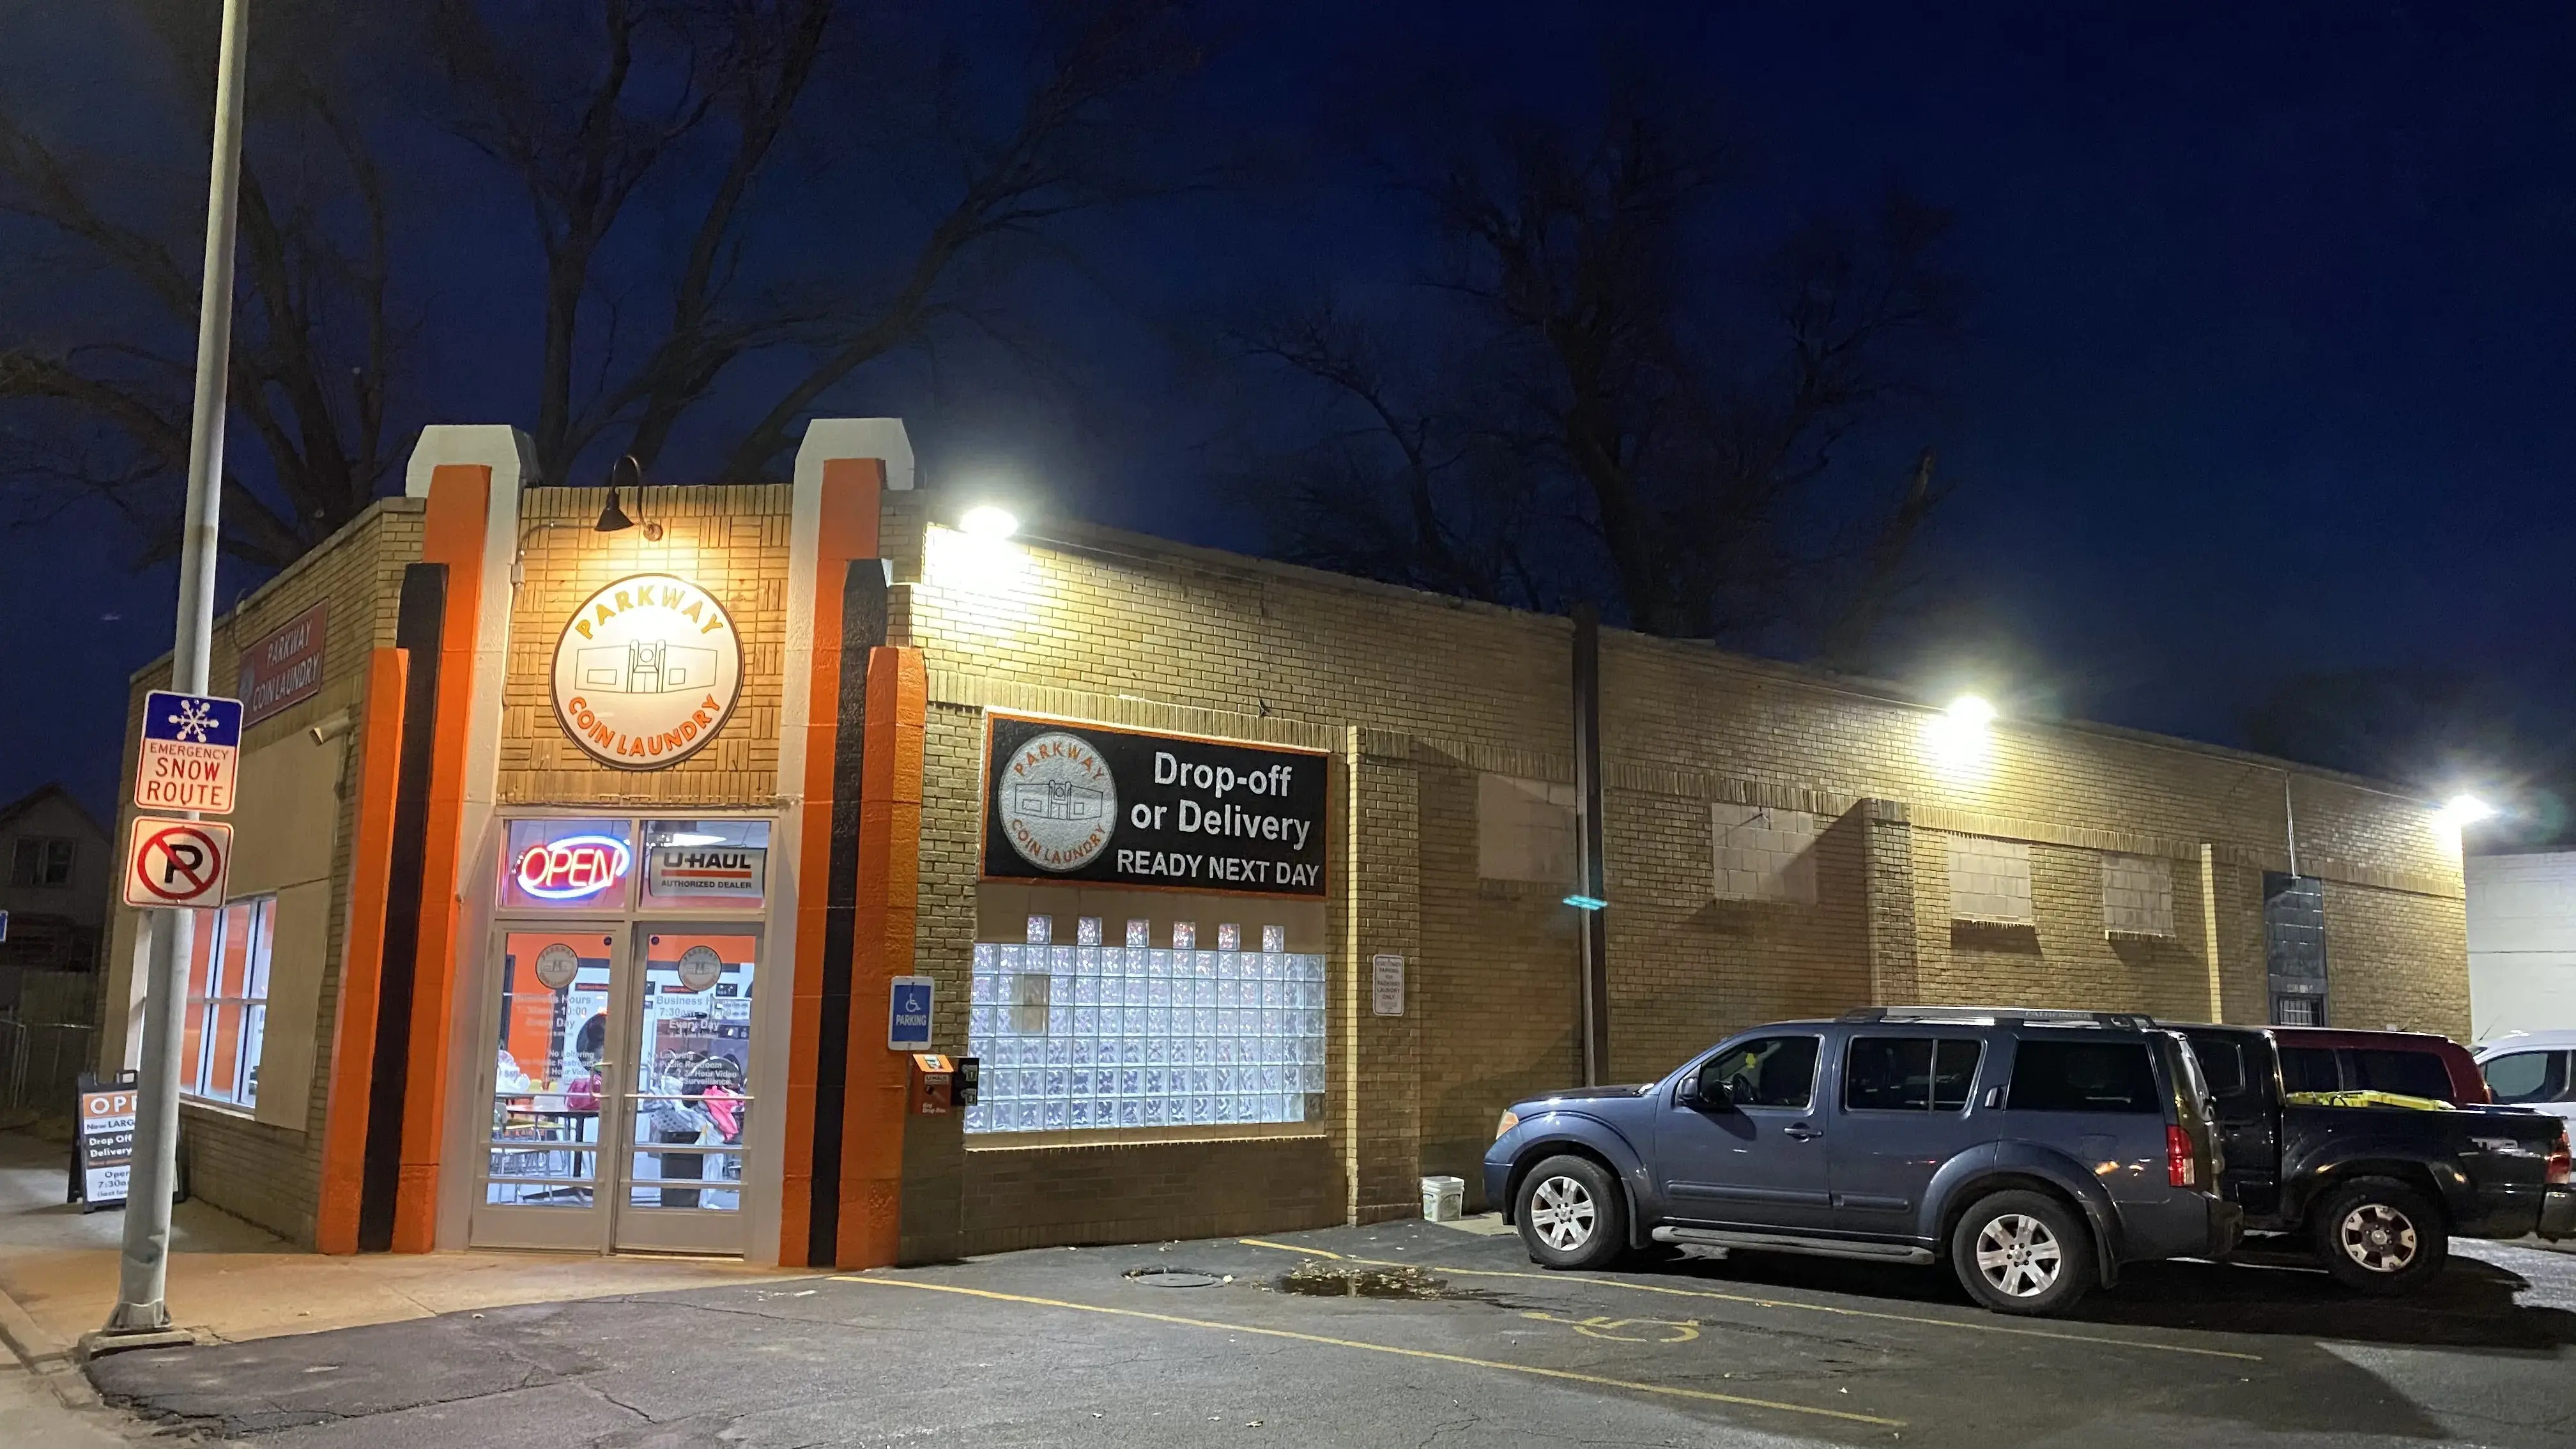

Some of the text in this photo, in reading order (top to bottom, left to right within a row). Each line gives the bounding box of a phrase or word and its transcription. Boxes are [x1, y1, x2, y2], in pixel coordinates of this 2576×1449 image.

[575, 585, 723, 640] PARKWAY
[266, 618, 312, 669] PARKWAY
[253, 652, 319, 711] COIN LAUNDRY
[569, 694, 720, 756] COIN LAUNDRY
[150, 742, 229, 760] EMERGENCY
[1014, 742, 1105, 780] PARKWAY
[155, 757, 220, 781] SNOW
[1154, 751, 1292, 799] Drop-off
[147, 781, 223, 806] ROUTE
[1131, 799, 1310, 851] or Delivery
[1012, 818, 1106, 864] COIN LAUNDRY
[522, 847, 621, 887] OPEN
[663, 852, 751, 870] U-HAUL
[1117, 849, 1320, 887] READY NEXT DAY
[661, 880, 752, 889] AUTHORIZED DEALER
[657, 995, 703, 1005] Business
[700, 1020, 719, 1032] Day
[896, 1014, 927, 1027] PARKING
[2025, 1011, 2092, 1019] PATHFINDER
[715, 1070, 737, 1078] Video
[90, 1094, 137, 1114] OP
[89, 1137, 114, 1146] Drop
[90, 1147, 133, 1158] Delivery
[98, 1180, 129, 1189] 7:30a
